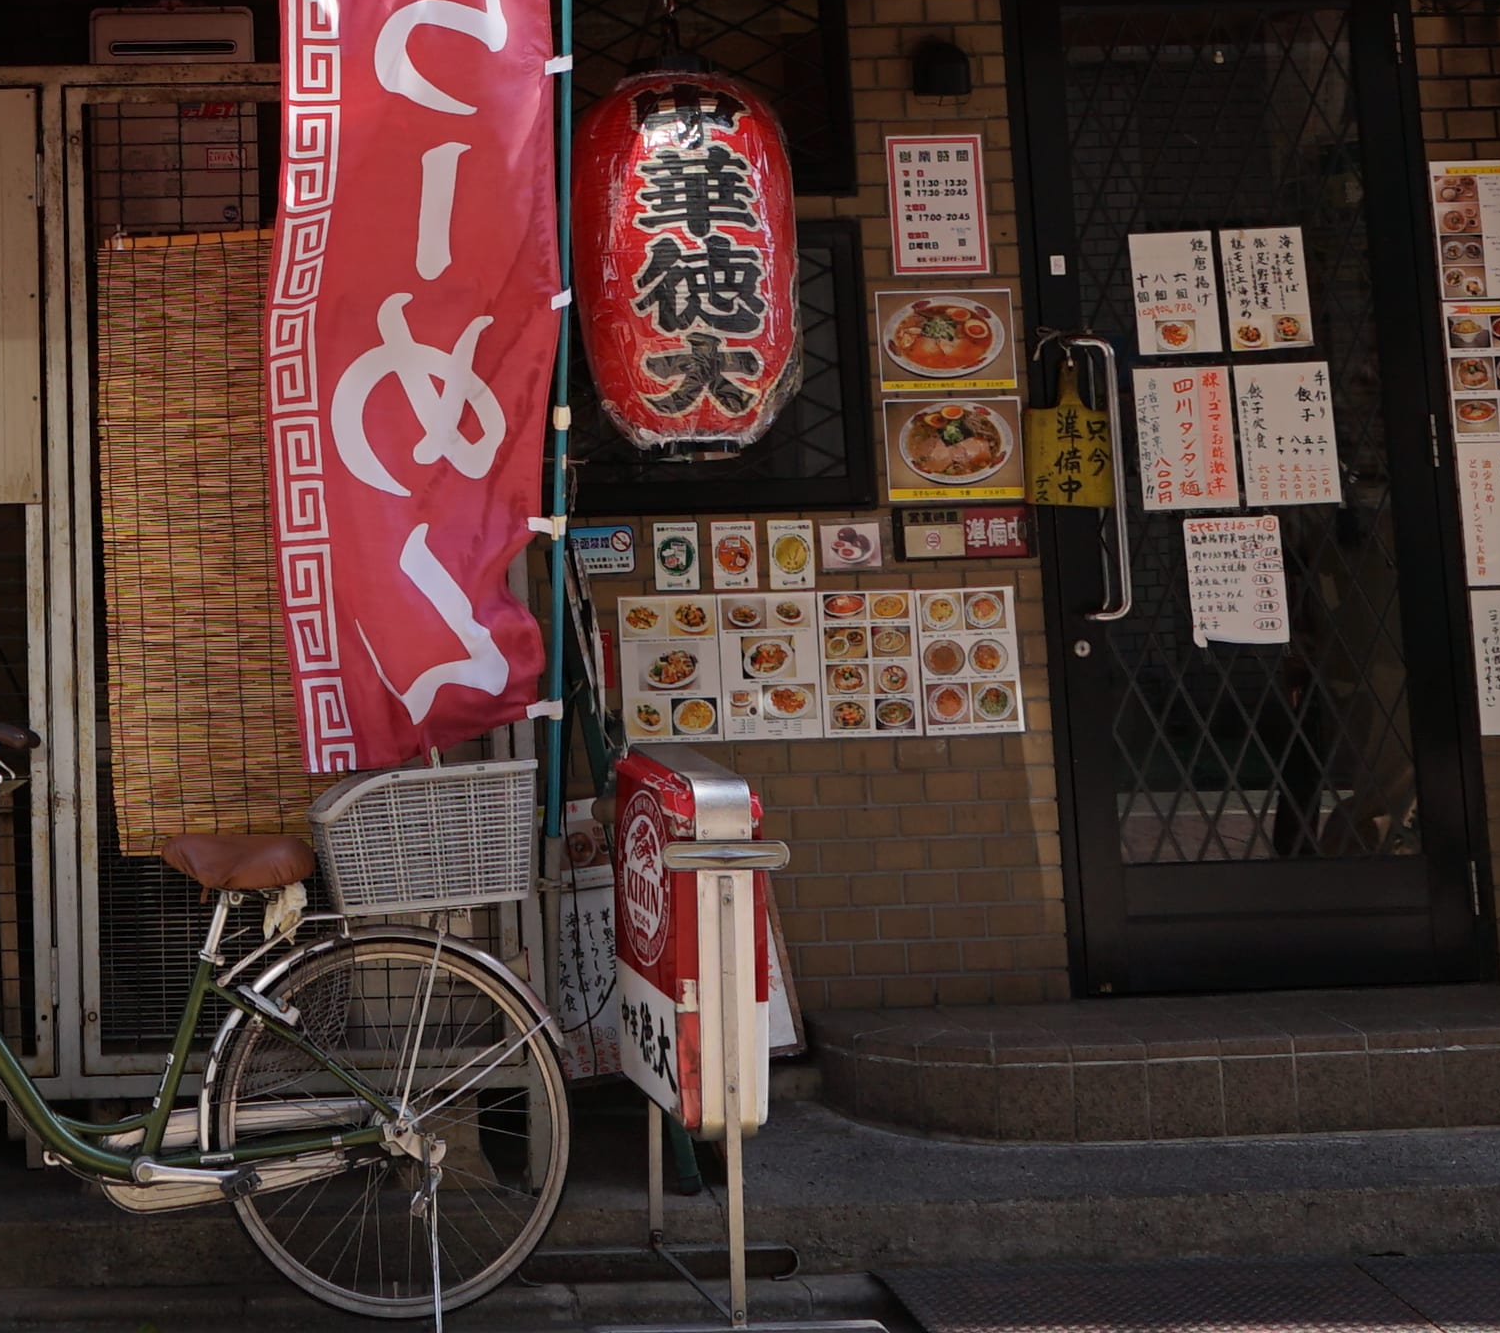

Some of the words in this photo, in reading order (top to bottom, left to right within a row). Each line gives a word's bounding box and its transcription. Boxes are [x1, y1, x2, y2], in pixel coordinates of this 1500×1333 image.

[630, 82, 767, 419] 中華徳大
[1053, 408, 1084, 503] 準備中
[1086, 420, 1109, 477] 只今
[1173, 378, 1203, 498] 四川タンタン麺
[1035, 471, 1055, 503] デス
[627, 867, 659, 919] KIRIN
[621, 993, 678, 1094] 中華徳大
